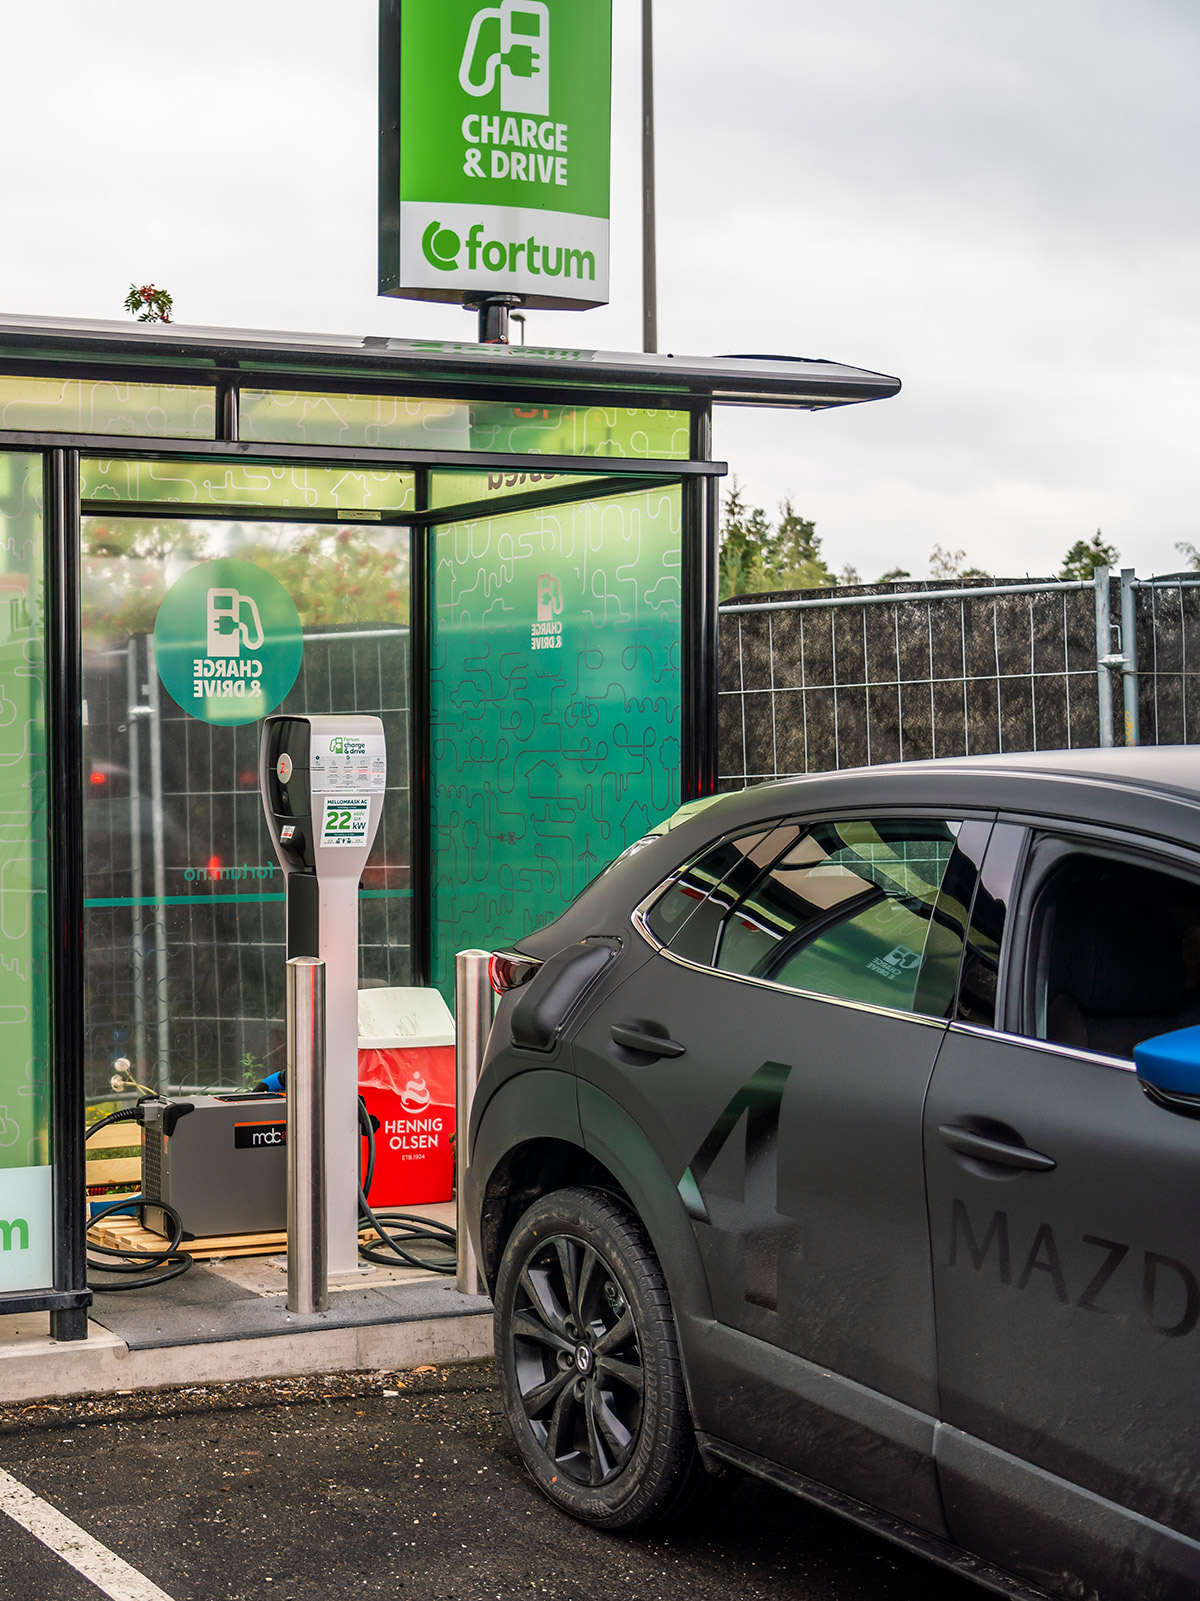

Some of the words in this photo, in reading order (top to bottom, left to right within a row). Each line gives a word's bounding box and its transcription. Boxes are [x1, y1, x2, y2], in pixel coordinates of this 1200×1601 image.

[461, 114, 568, 153] CHARGE
[462, 148, 487, 178] &
[491, 151, 568, 186] DRIVE
[465, 224, 596, 281] fortum
[325, 811, 352, 830] 22
[352, 822, 366, 830] kW
[384, 1118, 443, 1134] HENNIG
[389, 1134, 439, 1150] OLSEN
